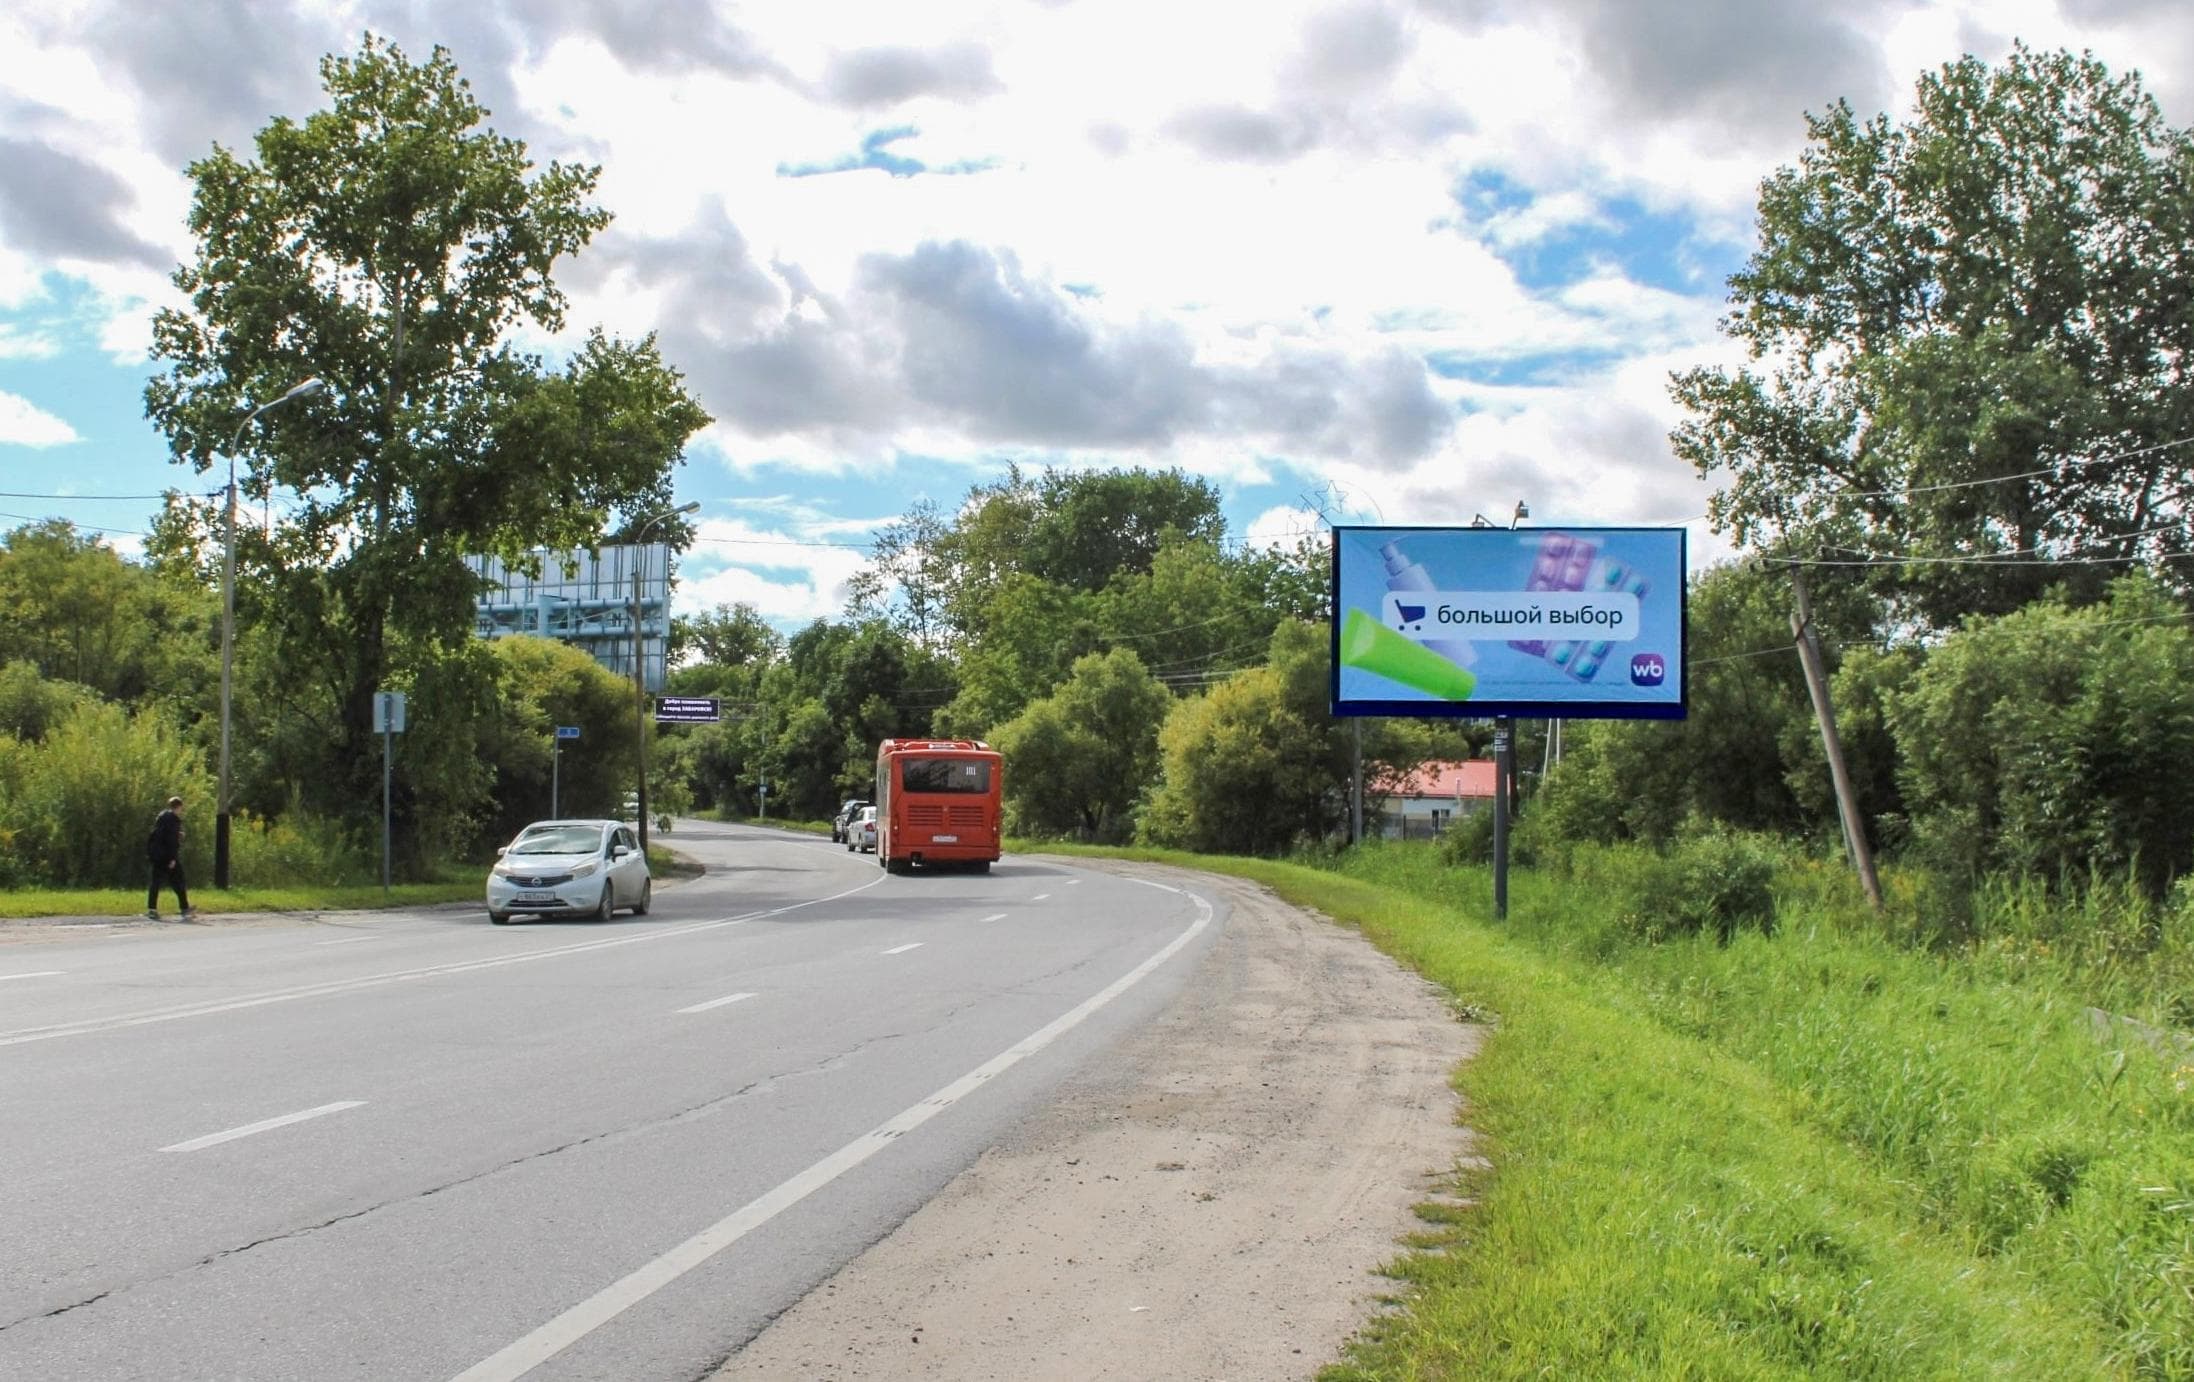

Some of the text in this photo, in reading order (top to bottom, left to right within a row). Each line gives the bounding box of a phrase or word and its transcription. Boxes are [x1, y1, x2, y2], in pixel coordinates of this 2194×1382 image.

[1438, 605, 1623, 629] большой выбор
[1633, 664, 1664, 678] wb
